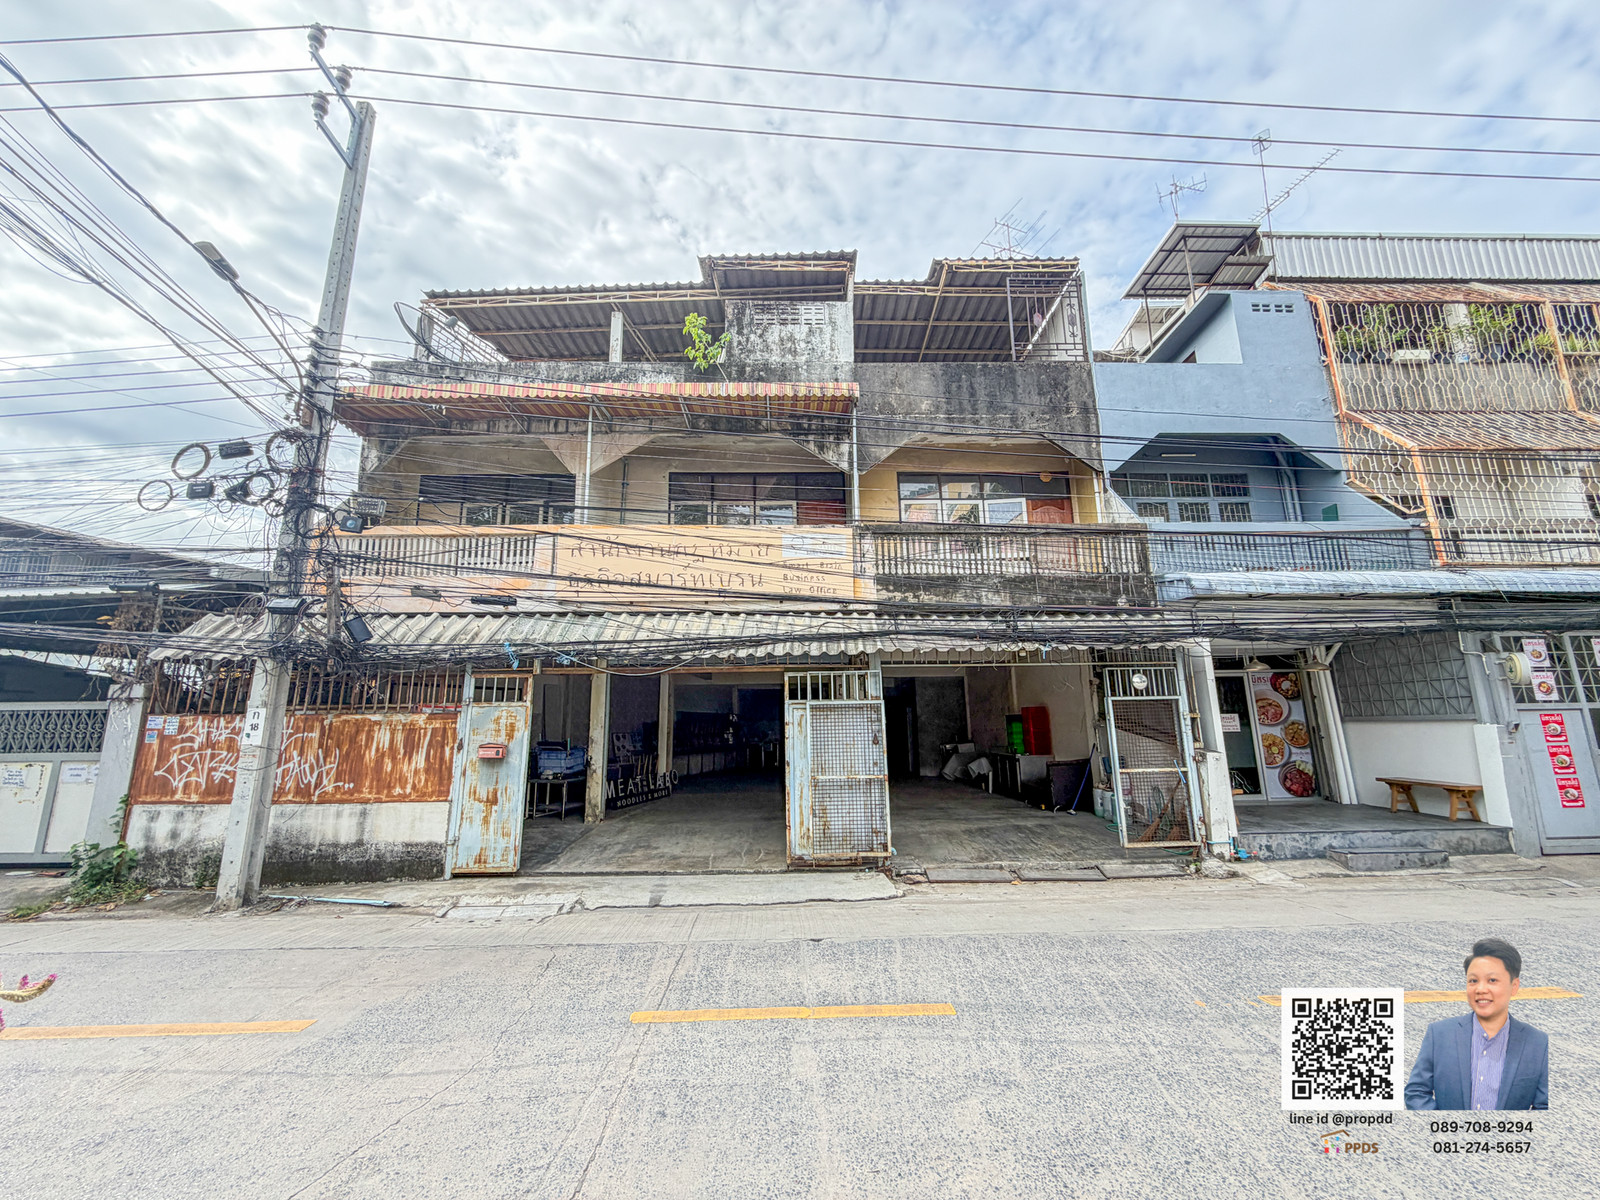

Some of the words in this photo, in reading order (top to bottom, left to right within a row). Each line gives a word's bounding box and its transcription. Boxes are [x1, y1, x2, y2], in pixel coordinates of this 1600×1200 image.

[783, 573, 826, 582] Business
[783, 586, 802, 594] Law
[809, 586, 838, 595] Office
[249, 722, 259, 732] 18
[605, 776, 641, 799] MEAT
[648, 769, 679, 790] LABO
[616, 795, 646, 807] NOODLES
